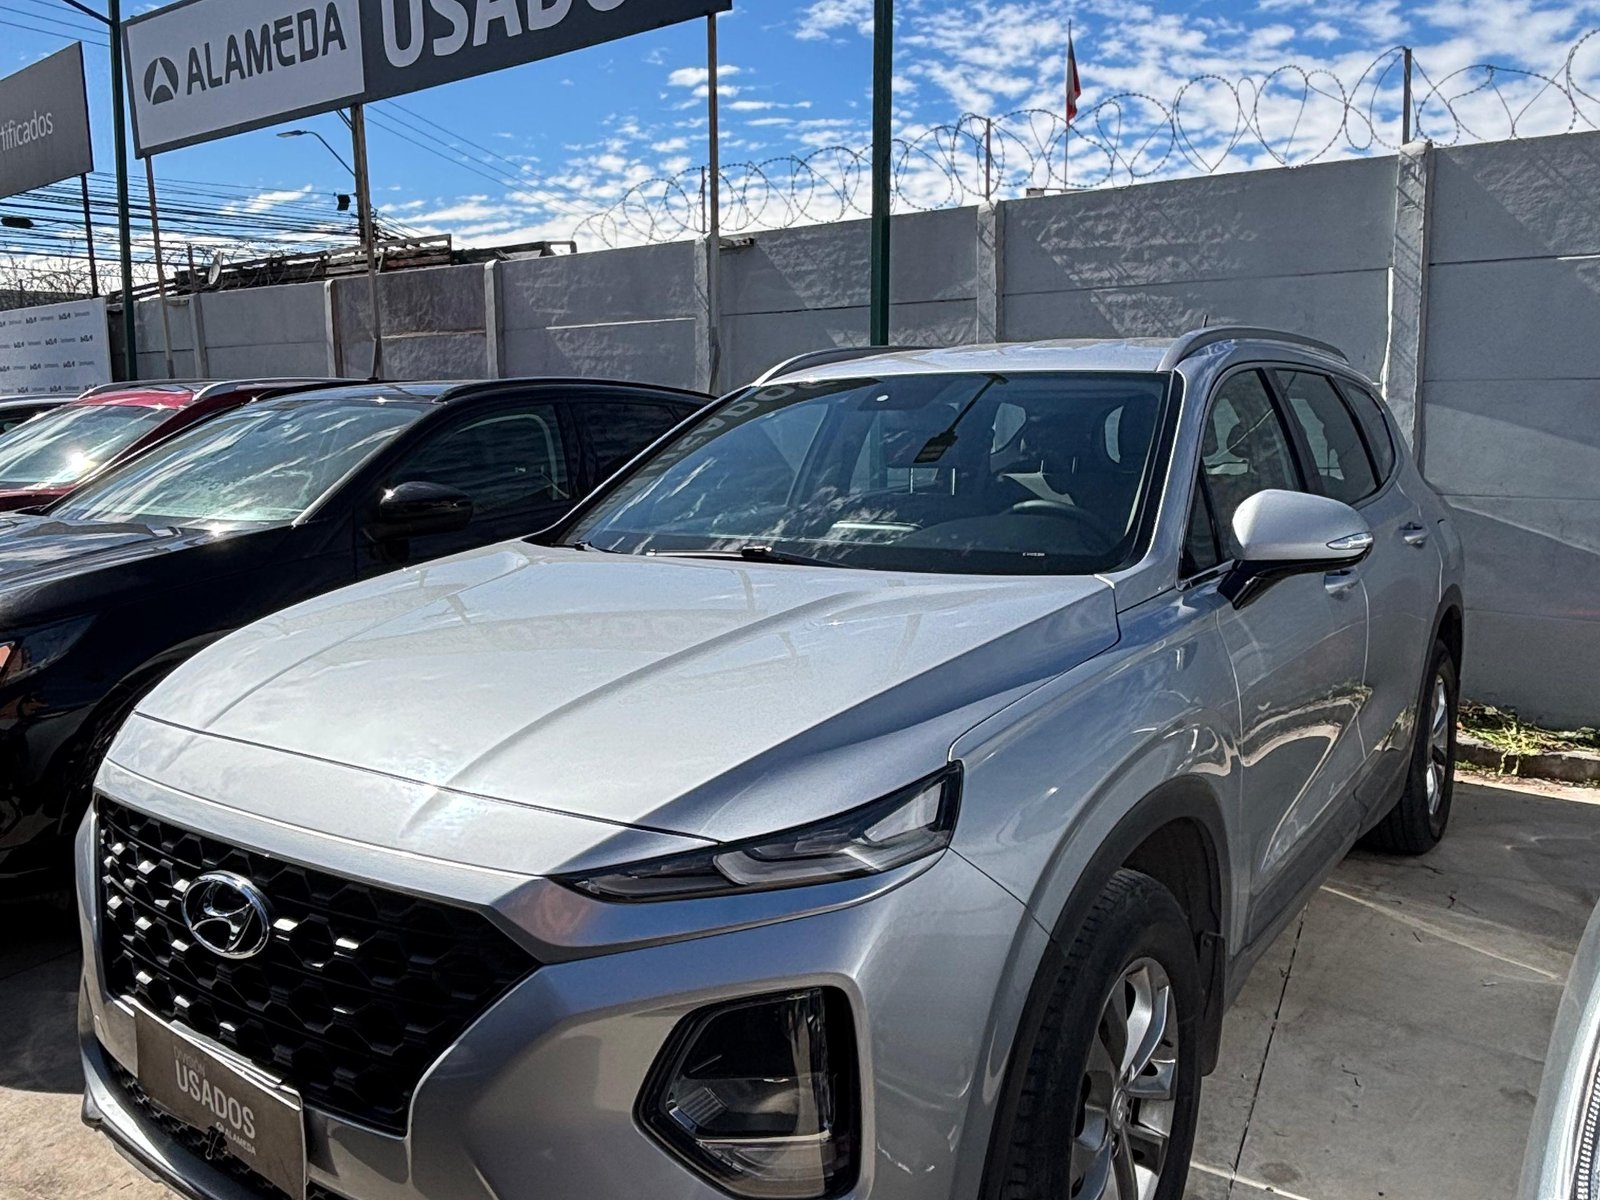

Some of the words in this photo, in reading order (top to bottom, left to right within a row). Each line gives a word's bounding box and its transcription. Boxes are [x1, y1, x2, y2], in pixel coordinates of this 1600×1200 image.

[187, 2, 347, 95] ALAMEDA
[381, 0, 626, 67] USA
[0, 109, 53, 151] tificados
[176, 1060, 256, 1139] USADOS
